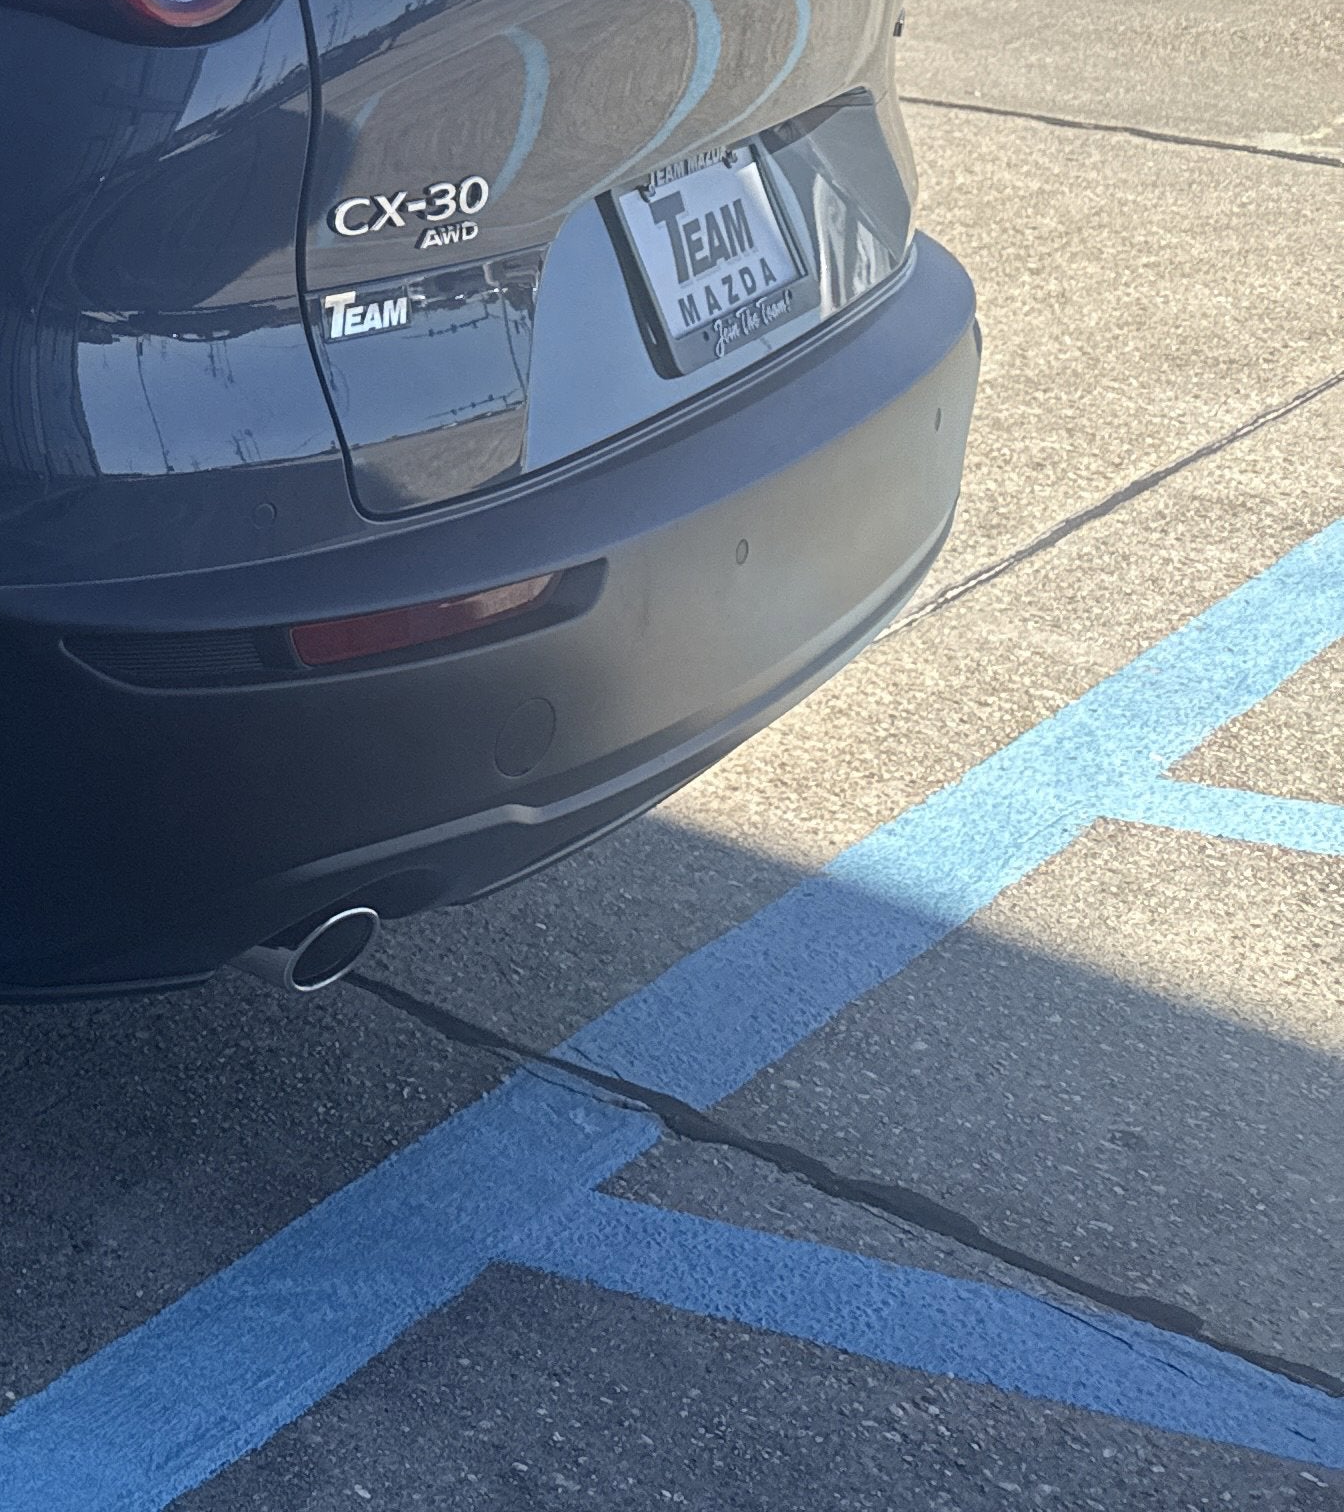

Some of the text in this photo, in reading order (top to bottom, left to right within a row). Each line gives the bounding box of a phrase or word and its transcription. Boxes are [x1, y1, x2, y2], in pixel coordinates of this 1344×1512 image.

[330, 174, 490, 237] CX-30
[417, 221, 480, 249] AWD
[649, 191, 755, 285] TEAM
[324, 291, 408, 339] TEAM
[677, 257, 778, 328] MAZDA
